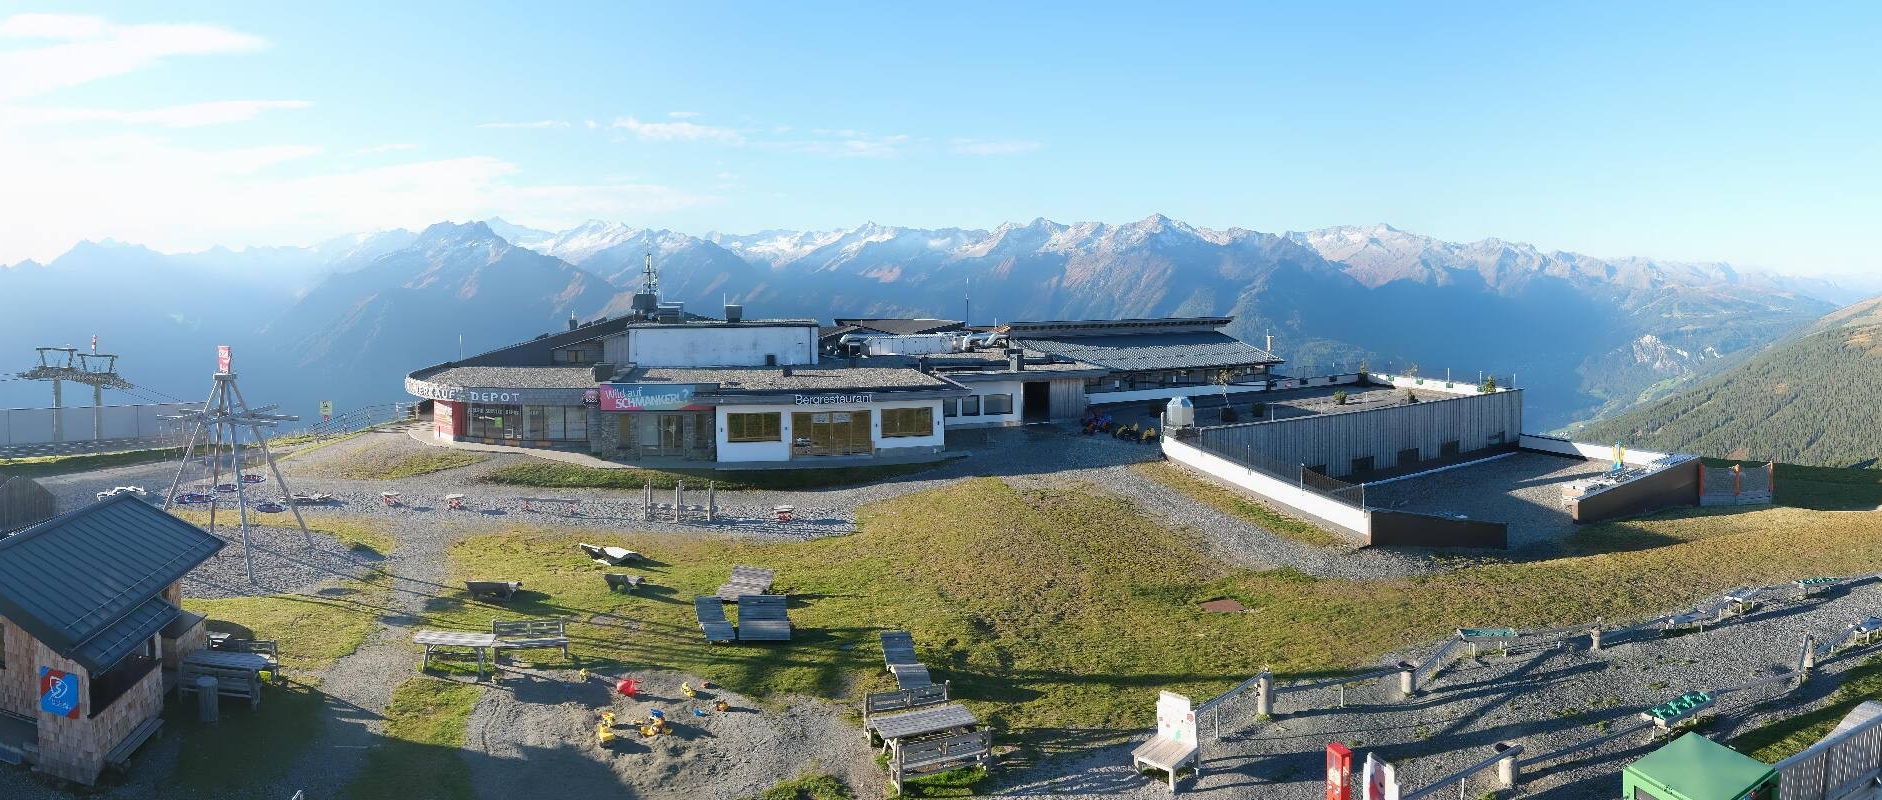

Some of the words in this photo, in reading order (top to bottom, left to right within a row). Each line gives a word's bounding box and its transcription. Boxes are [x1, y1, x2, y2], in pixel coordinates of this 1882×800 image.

[470, 391, 520, 402] DEPOT
[605, 388, 625, 400] Wild
[628, 386, 643, 398] auf
[795, 393, 873, 405] Bergrestaurant
